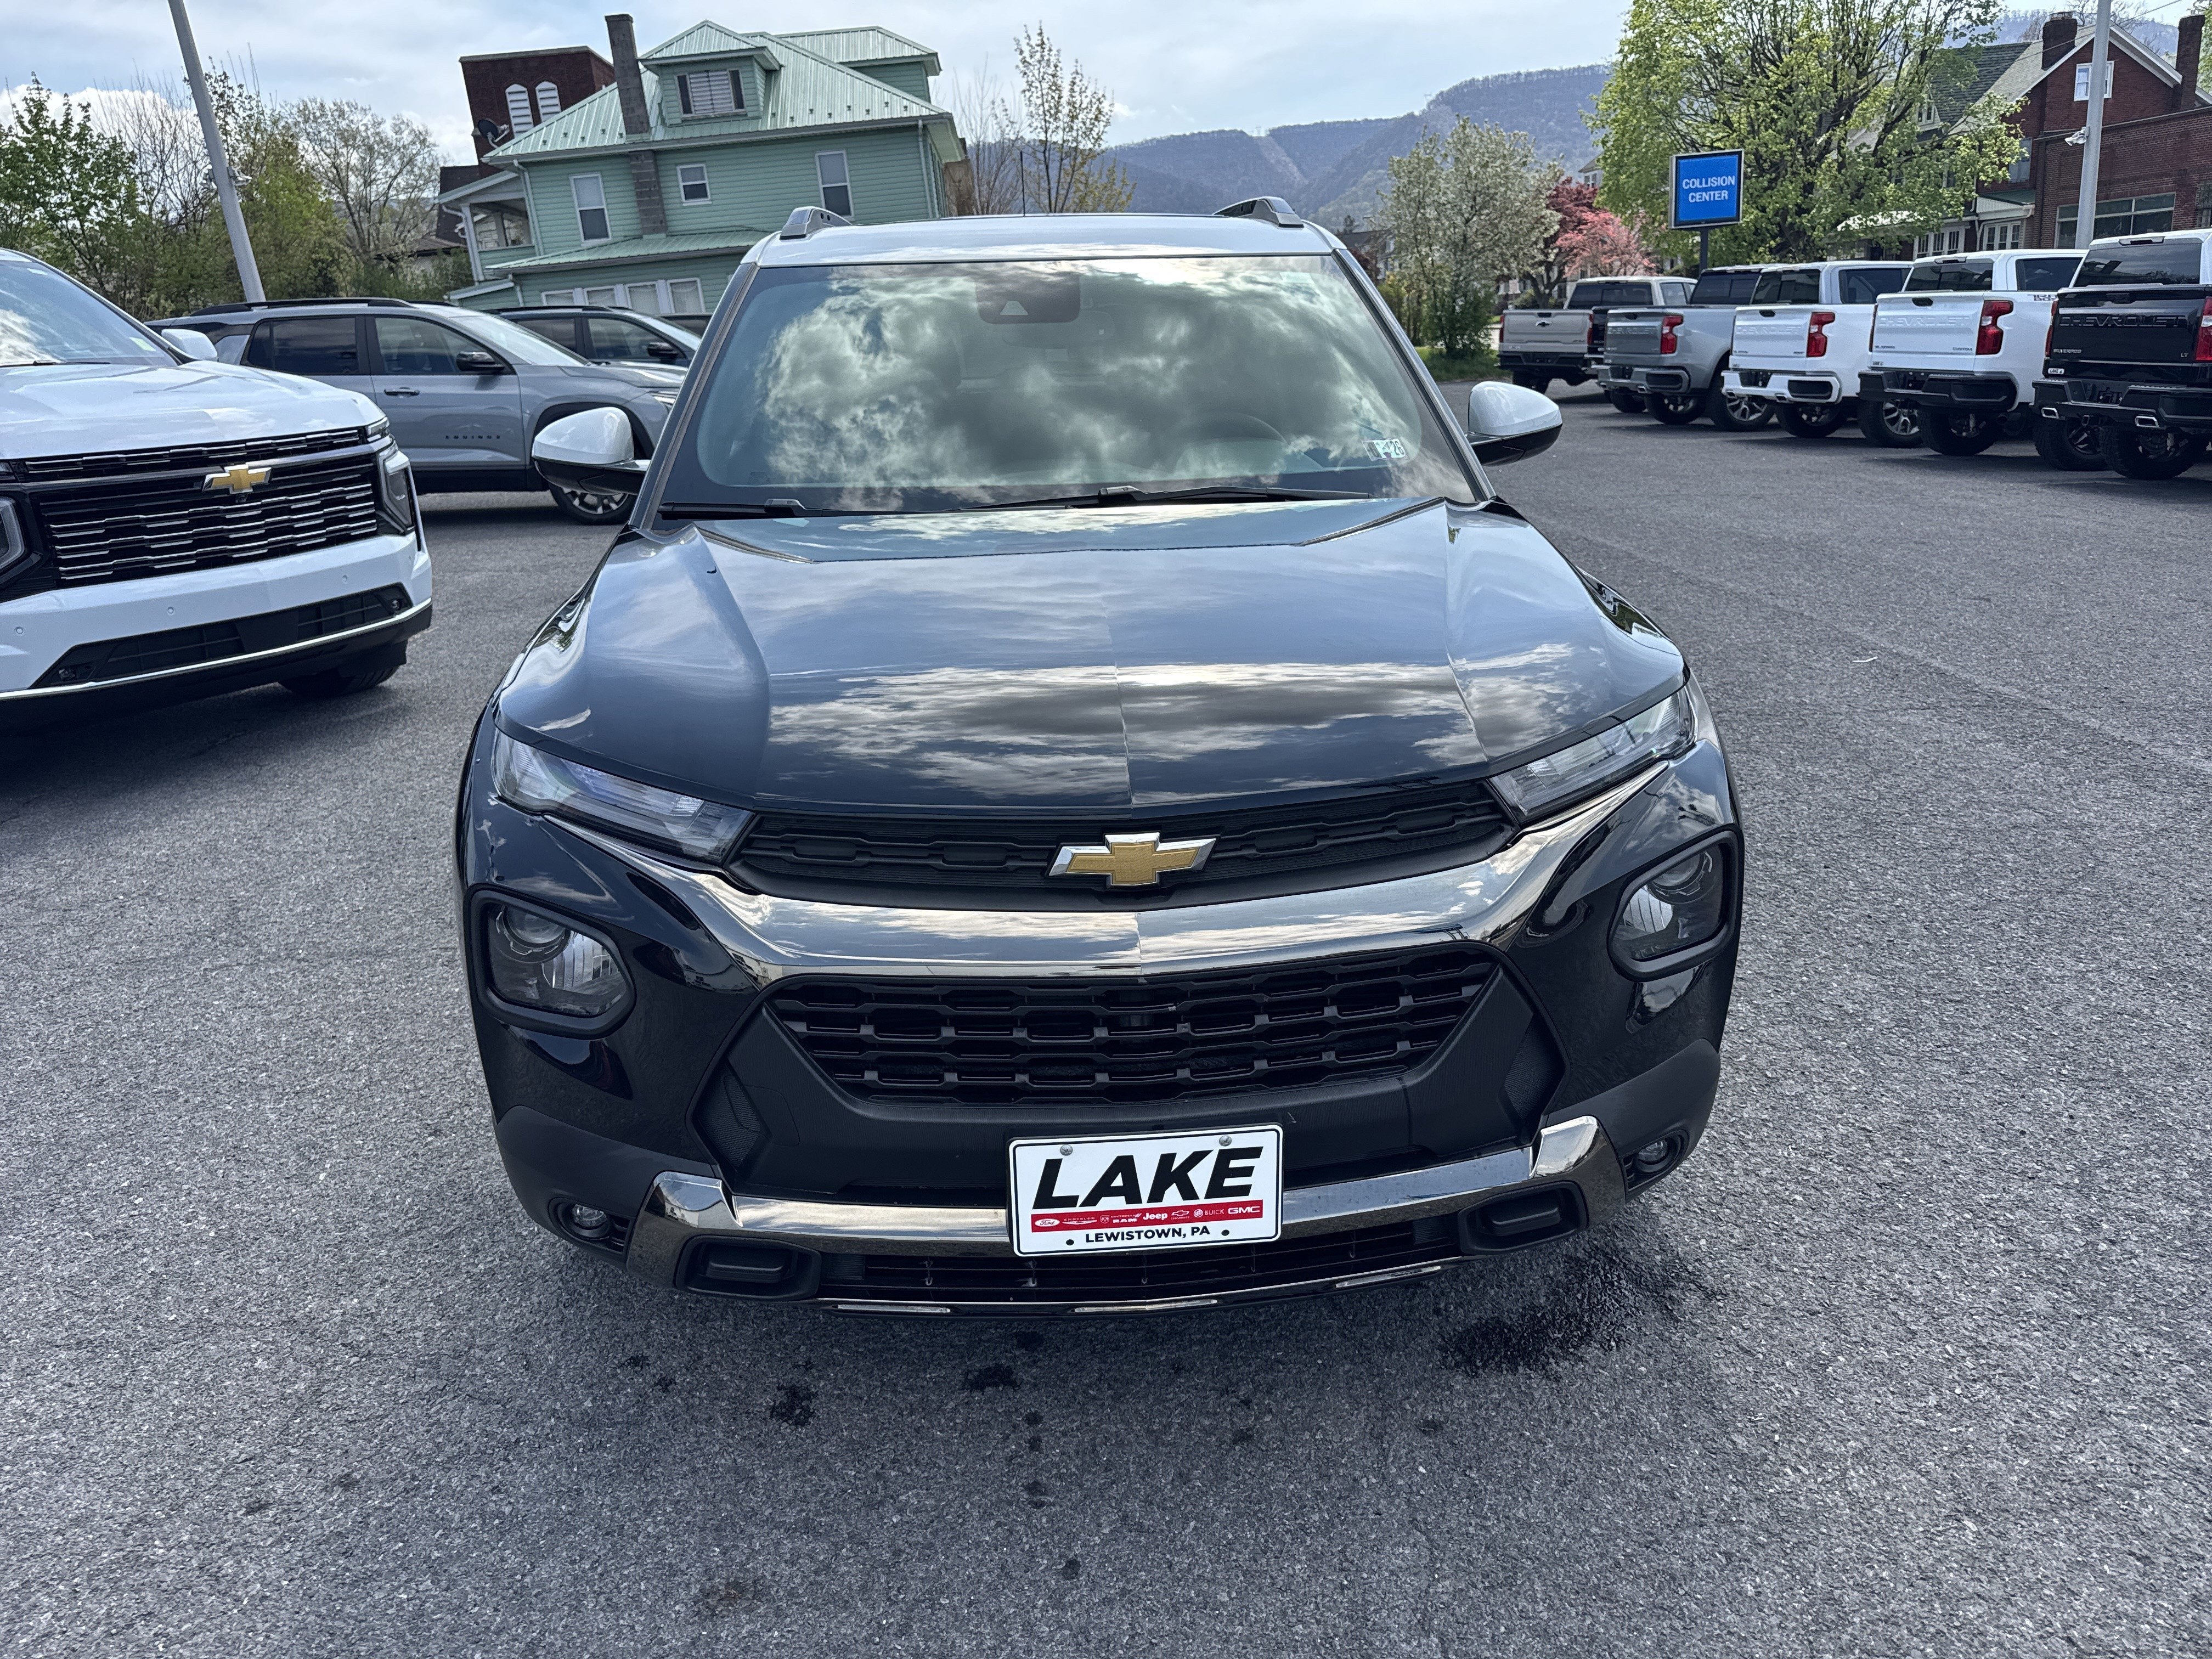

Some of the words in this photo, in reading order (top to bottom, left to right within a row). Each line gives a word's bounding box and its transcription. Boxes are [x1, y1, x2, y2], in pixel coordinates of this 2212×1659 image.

[1682, 176, 1736, 189] COLLISION
[1688, 190, 1729, 202] CENTER
[1878, 315, 1970, 326] CHEVROLET
[2059, 315, 2186, 327] CHEVROLET
[1032, 1146, 1264, 1210] LAKE
[1143, 1212, 1168, 1221] Jeep
[1228, 1206, 1260, 1214] GMC
[1086, 1227, 1187, 1243] LEWISTOWN,
[1191, 1225, 1211, 1236] PA
